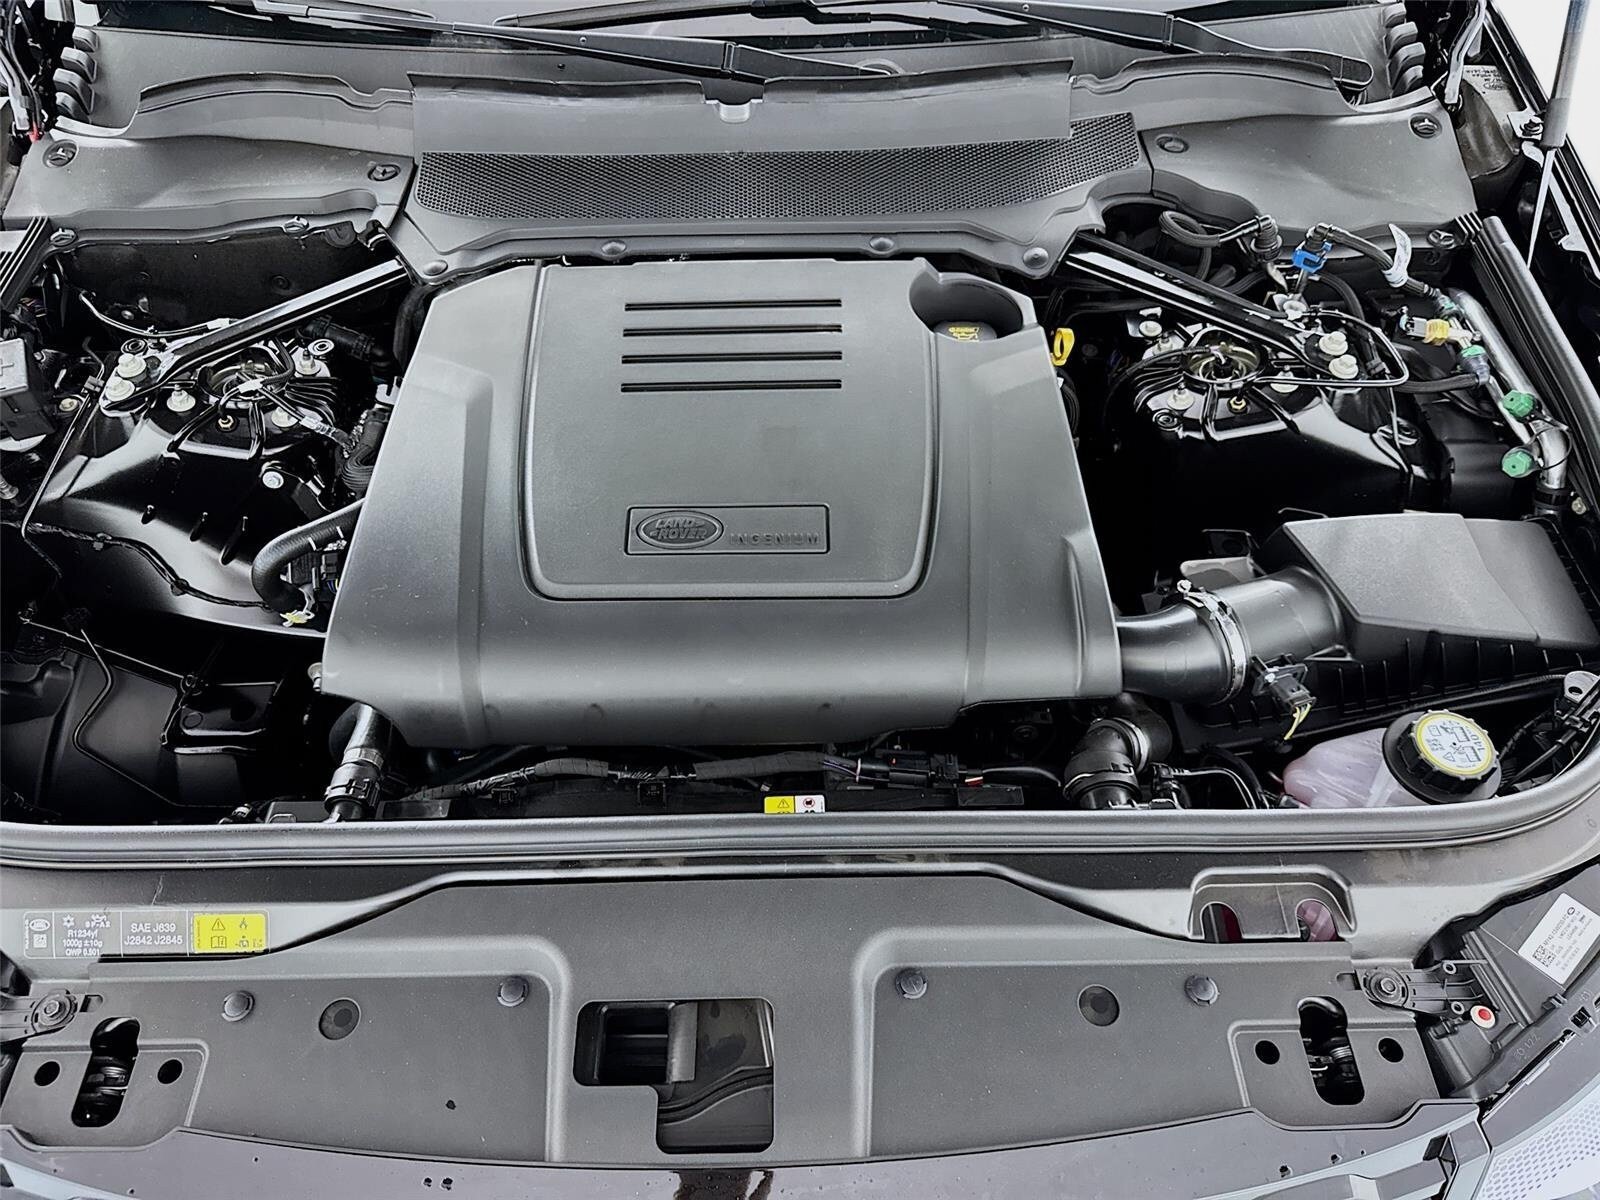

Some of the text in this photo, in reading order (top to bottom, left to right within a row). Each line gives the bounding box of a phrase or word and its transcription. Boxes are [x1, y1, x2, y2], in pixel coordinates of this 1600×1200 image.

[655, 518, 694, 528] LAND
[657, 528, 707, 540] ROVER
[729, 532, 820, 546] INGENIUM
[130, 923, 176, 933] SAE J639
[67, 929, 98, 939] R1234yf
[62, 939, 83, 949] 1000g
[124, 934, 183, 945] J2842 J2845
